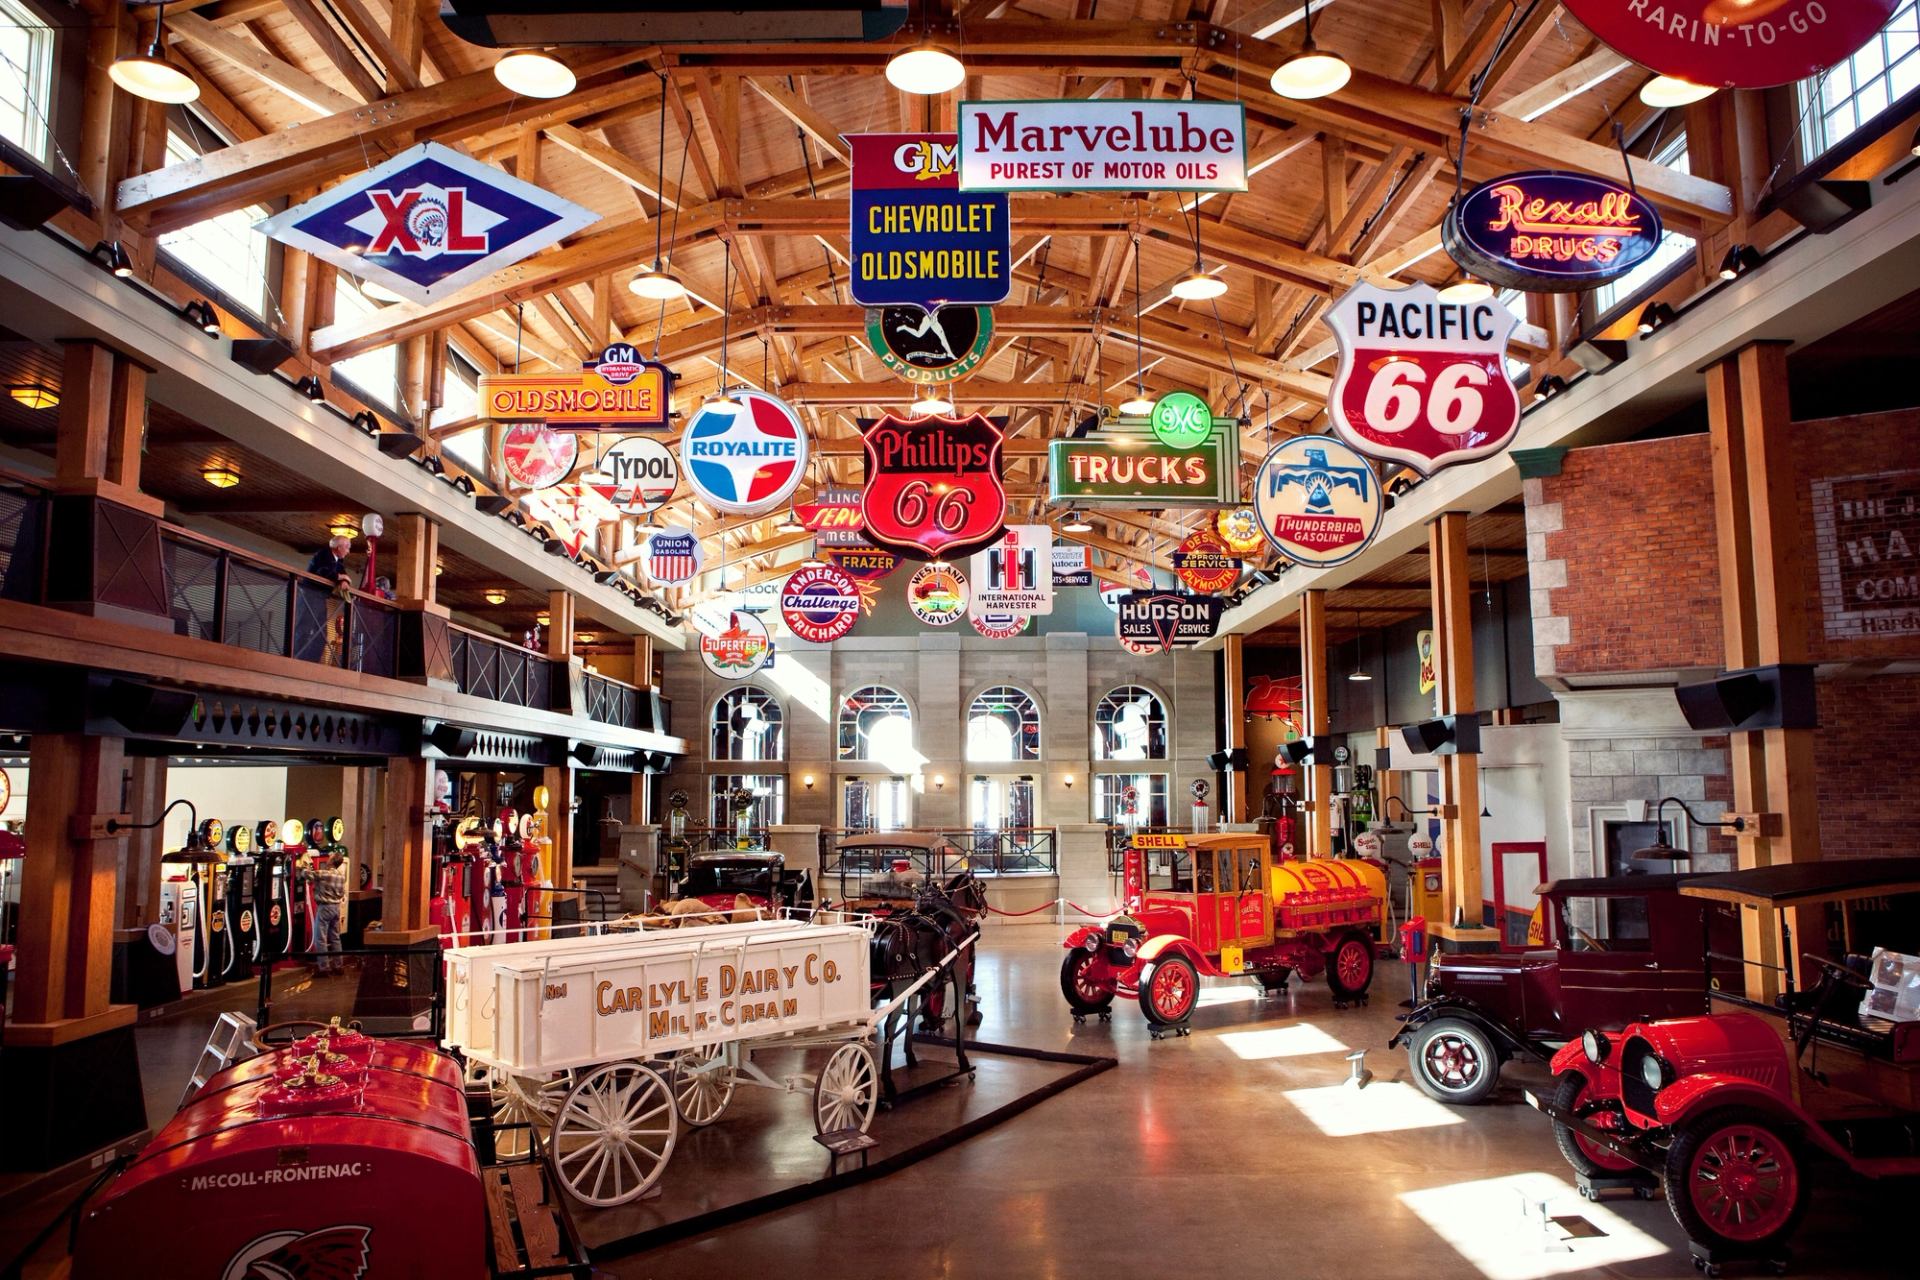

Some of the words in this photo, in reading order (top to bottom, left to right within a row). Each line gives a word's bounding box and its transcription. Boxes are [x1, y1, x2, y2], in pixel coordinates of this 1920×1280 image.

[974, 111, 1235, 154] Marvelube
[893, 142, 959, 174] GM
[990, 162, 1064, 180] PUREST
[1072, 162, 1093, 180] OF
[1104, 161, 1166, 180] MOTOR
[1176, 162, 1218, 180] OILS
[869, 204, 996, 233] CHEVROLET
[1489, 185, 1642, 234] Rexall
[1510, 235, 1622, 263] DRUGS
[861, 250, 999, 281] OLDSMOBILE
[1358, 301, 1494, 342] PACIFIC
[604, 347, 634, 364] GM
[882, 352, 980, 382] PRODUCTS
[493, 389, 651, 413] OLDSMOBILE
[1363, 362, 1491, 436] 66
[691, 441, 796, 458] ROYALITE
[875, 429, 989, 477] Phillips
[608, 451, 674, 484] TYDOL
[1068, 455, 1207, 485] TRUCKS
[893, 480, 976, 535] 66
[1279, 516, 1361, 533] THUNDERBIRD
[656, 540, 690, 548] UNION
[1294, 531, 1345, 543] GASOLINE
[842, 556, 895, 569] FRAZER
[1181, 560, 1234, 568] SERVICE
[791, 568, 854, 595] ANDERSON
[1183, 570, 1233, 590] PLYMOUTH
[783, 595, 858, 610] Challenge
[986, 601, 1037, 609] HARVESTER
[1122, 604, 1209, 620] HUDSON
[788, 612, 853, 639] PRICHARD
[916, 607, 962, 624] SERVICE
[972, 616, 1026, 639] PRODUCTS
[1123, 624, 1151, 634] SALES
[1178, 624, 1210, 634] SERVICE
[706, 638, 762, 651] SUPERTEST
[1137, 836, 1180, 847] SHELL
[1412, 841, 1432, 849] SHELL
[596, 976, 709, 1017] CARLYLE
[719, 964, 798, 998] DAIRY
[649, 998, 798, 1040] MILK-CREAM
[191, 1162, 361, 1191] McCOLL-FRONTENAC
